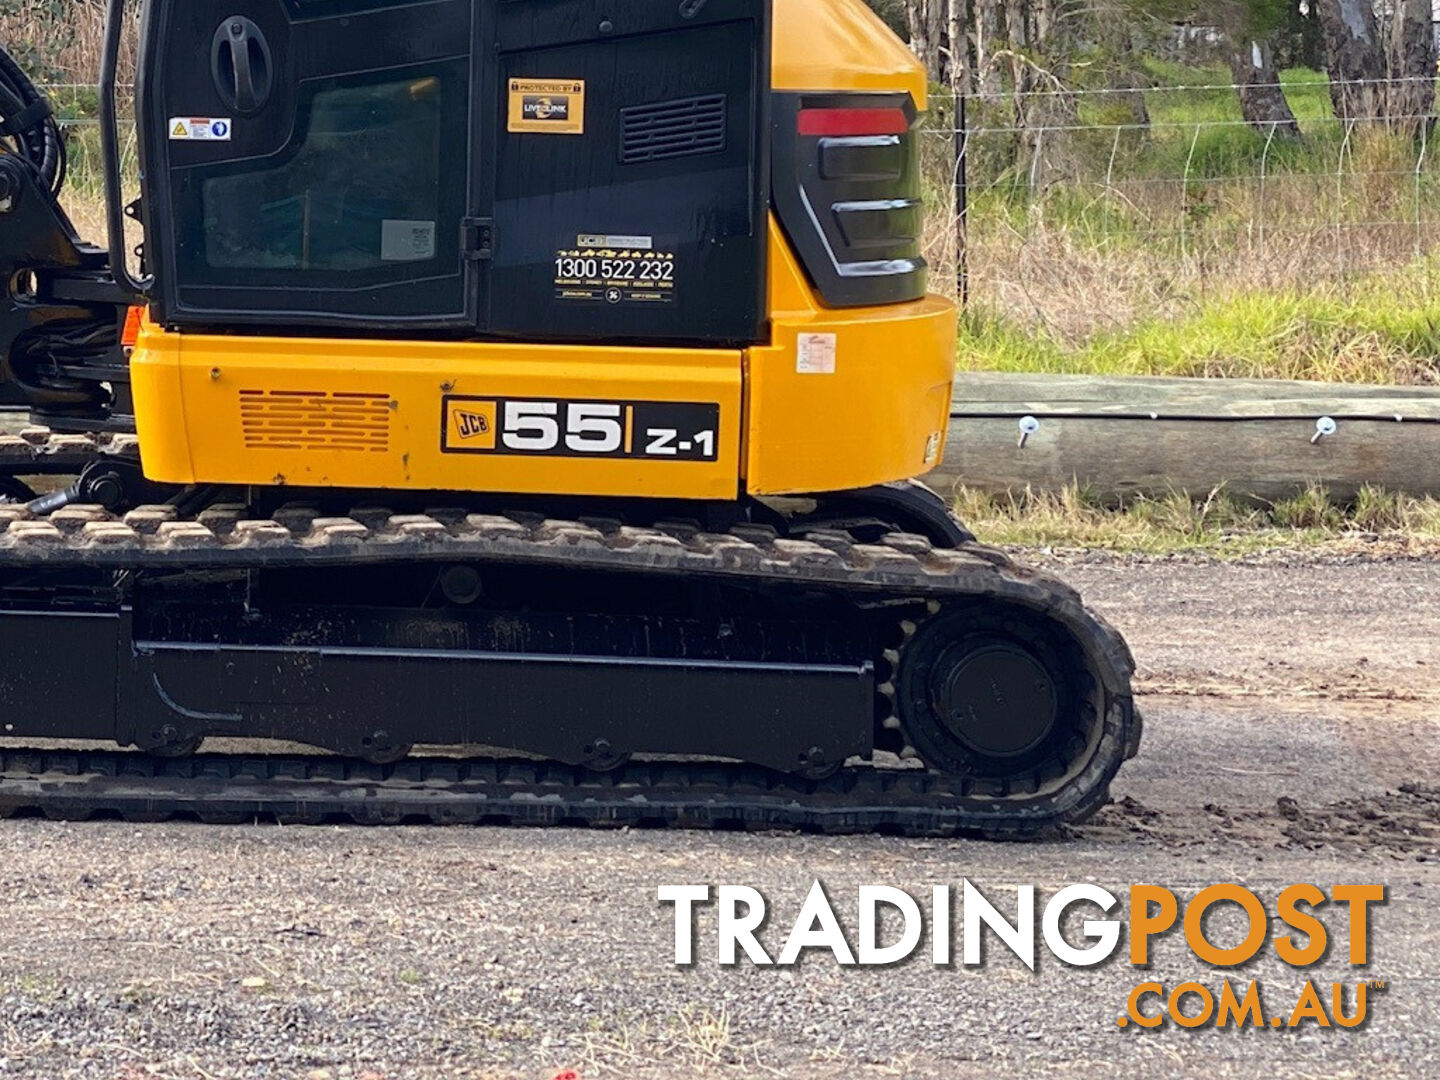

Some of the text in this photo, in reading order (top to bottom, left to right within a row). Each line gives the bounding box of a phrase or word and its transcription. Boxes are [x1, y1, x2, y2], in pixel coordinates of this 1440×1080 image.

[554, 258, 674, 280] 1300 522 232
[459, 401, 714, 457] JCB 55 Z-1
